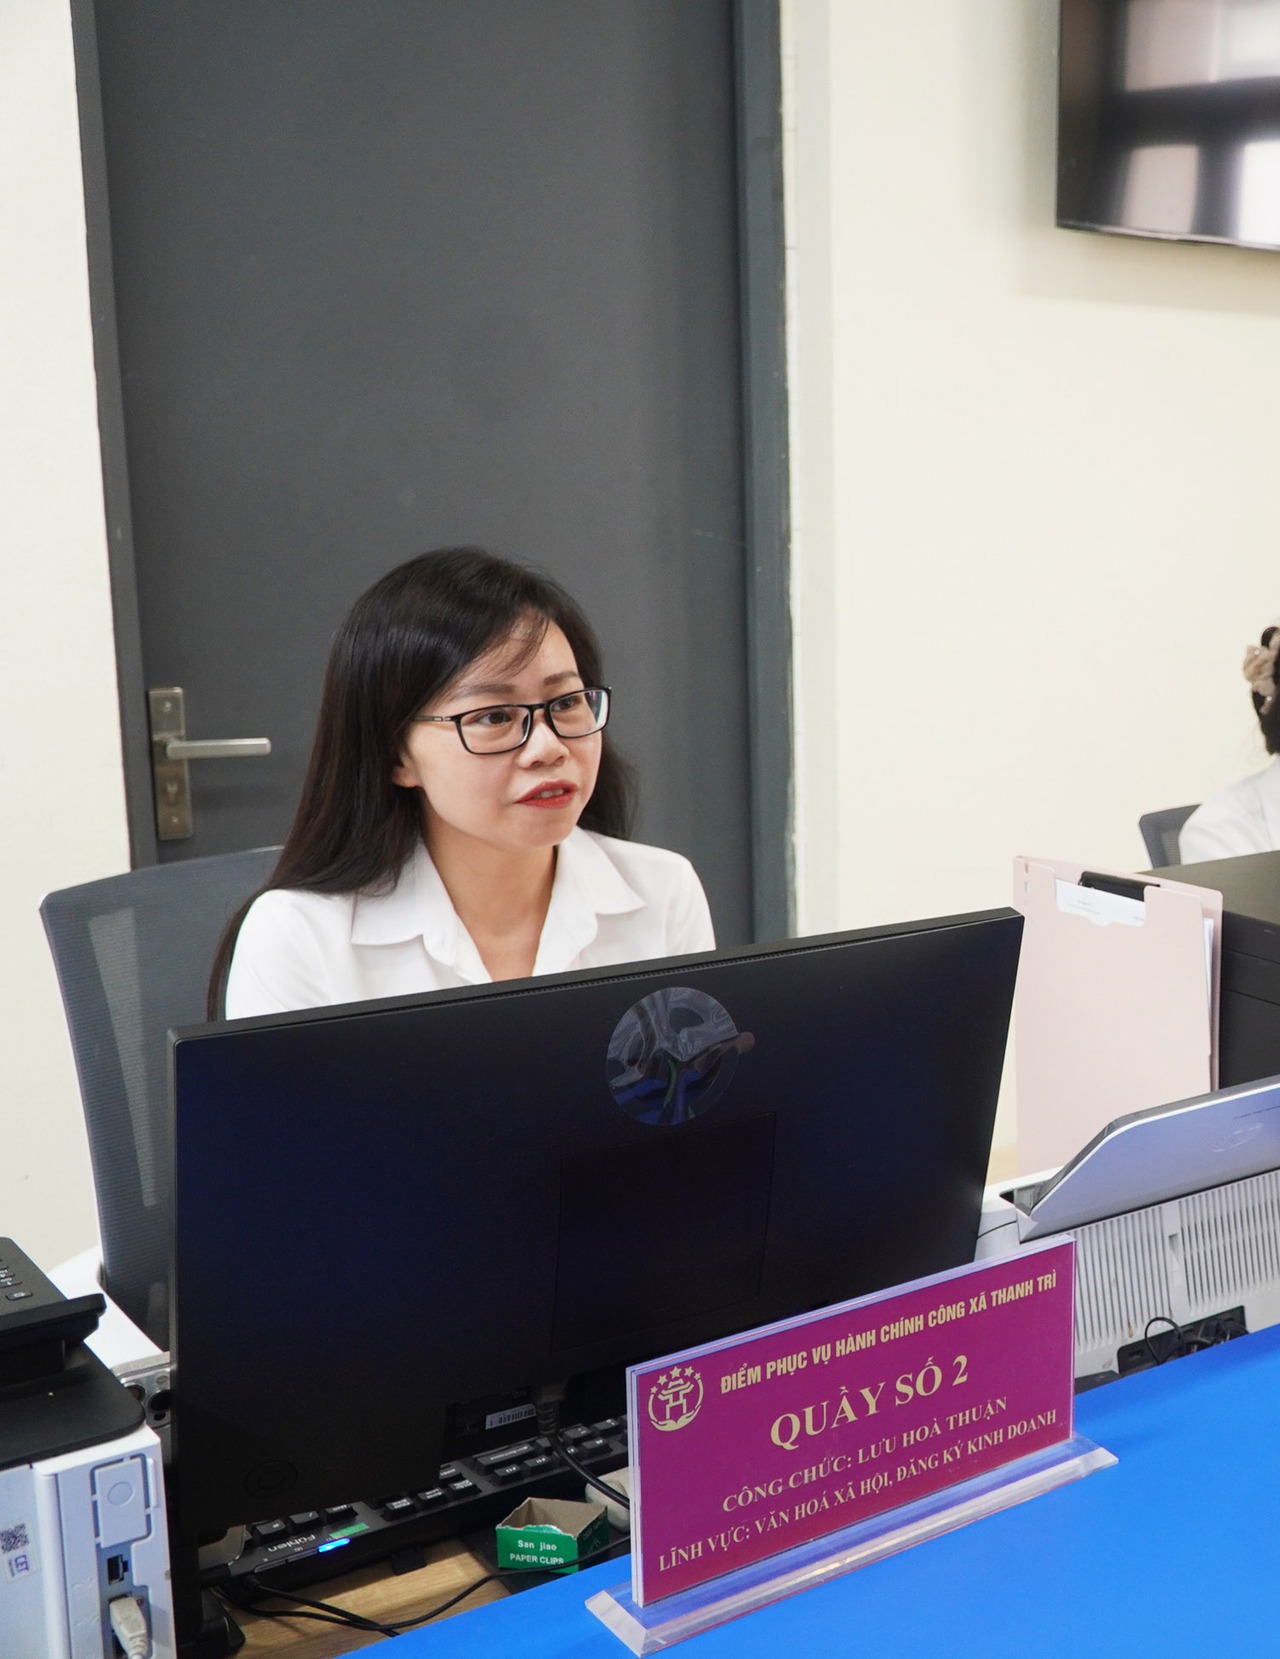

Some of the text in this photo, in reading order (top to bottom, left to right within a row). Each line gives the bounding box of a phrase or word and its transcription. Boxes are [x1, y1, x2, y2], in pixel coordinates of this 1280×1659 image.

[720, 1269, 1057, 1395] ĐIỂM PHỤC VỤ HÀNH CHÍNH CÔNG XÃ THANH TRÌ
[722, 1396, 1008, 1512] CÔNG CHỨC: LƯU HOÀ THUẬN
[770, 1354, 969, 1451] QUẦY SỐ 2
[658, 1409, 1058, 1572] LĨNH VỰC: VĂN HOÁ XÃ HỘI, ĐĂNG KÝ KINH DOANH
[509, 1552, 565, 1566] PAPER CLIPS
[517, 1539, 557, 1552] San jiao
